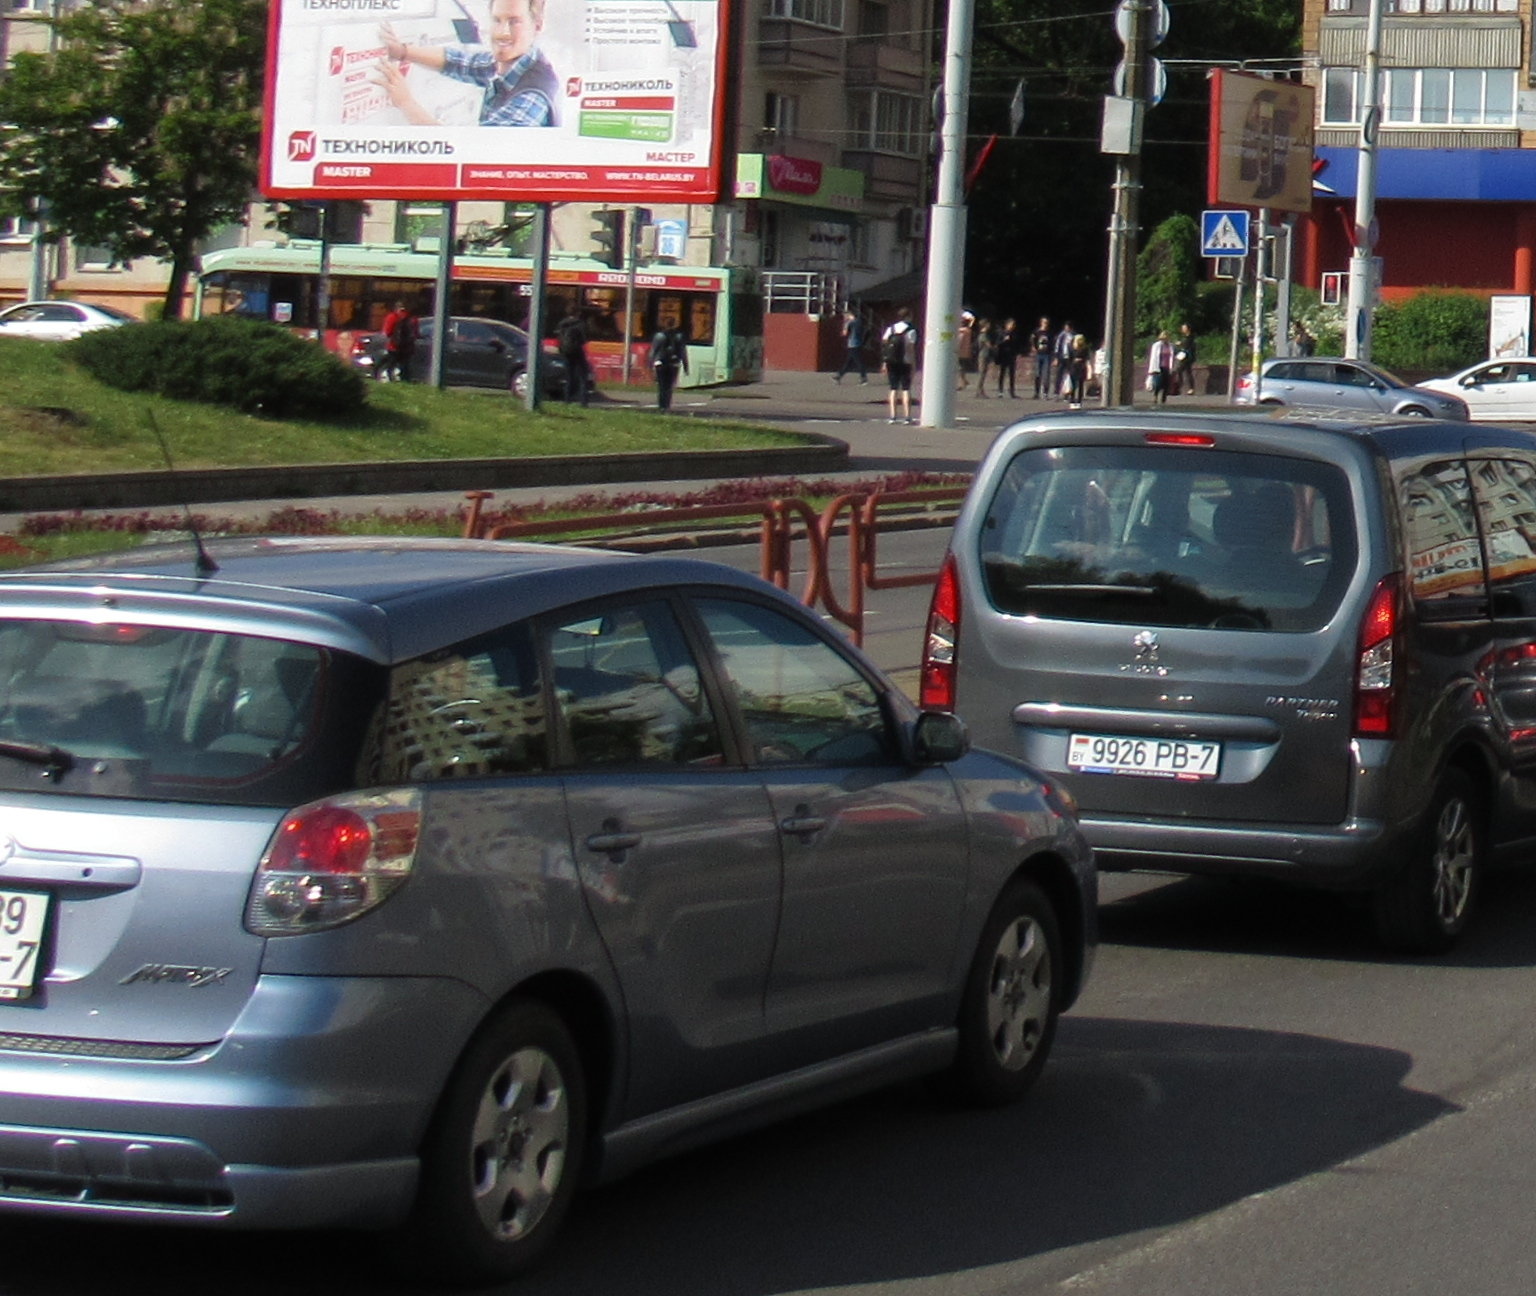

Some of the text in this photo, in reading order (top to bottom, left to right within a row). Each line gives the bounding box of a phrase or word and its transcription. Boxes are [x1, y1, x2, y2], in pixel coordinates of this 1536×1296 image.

[322, 139, 455, 155] ТЕХНОНИКОЛЬ
[645, 152, 696, 163] МАСТЕР
[322, 166, 372, 177] MASTER
[1072, 738, 1216, 770] BY 9926 PB-7
